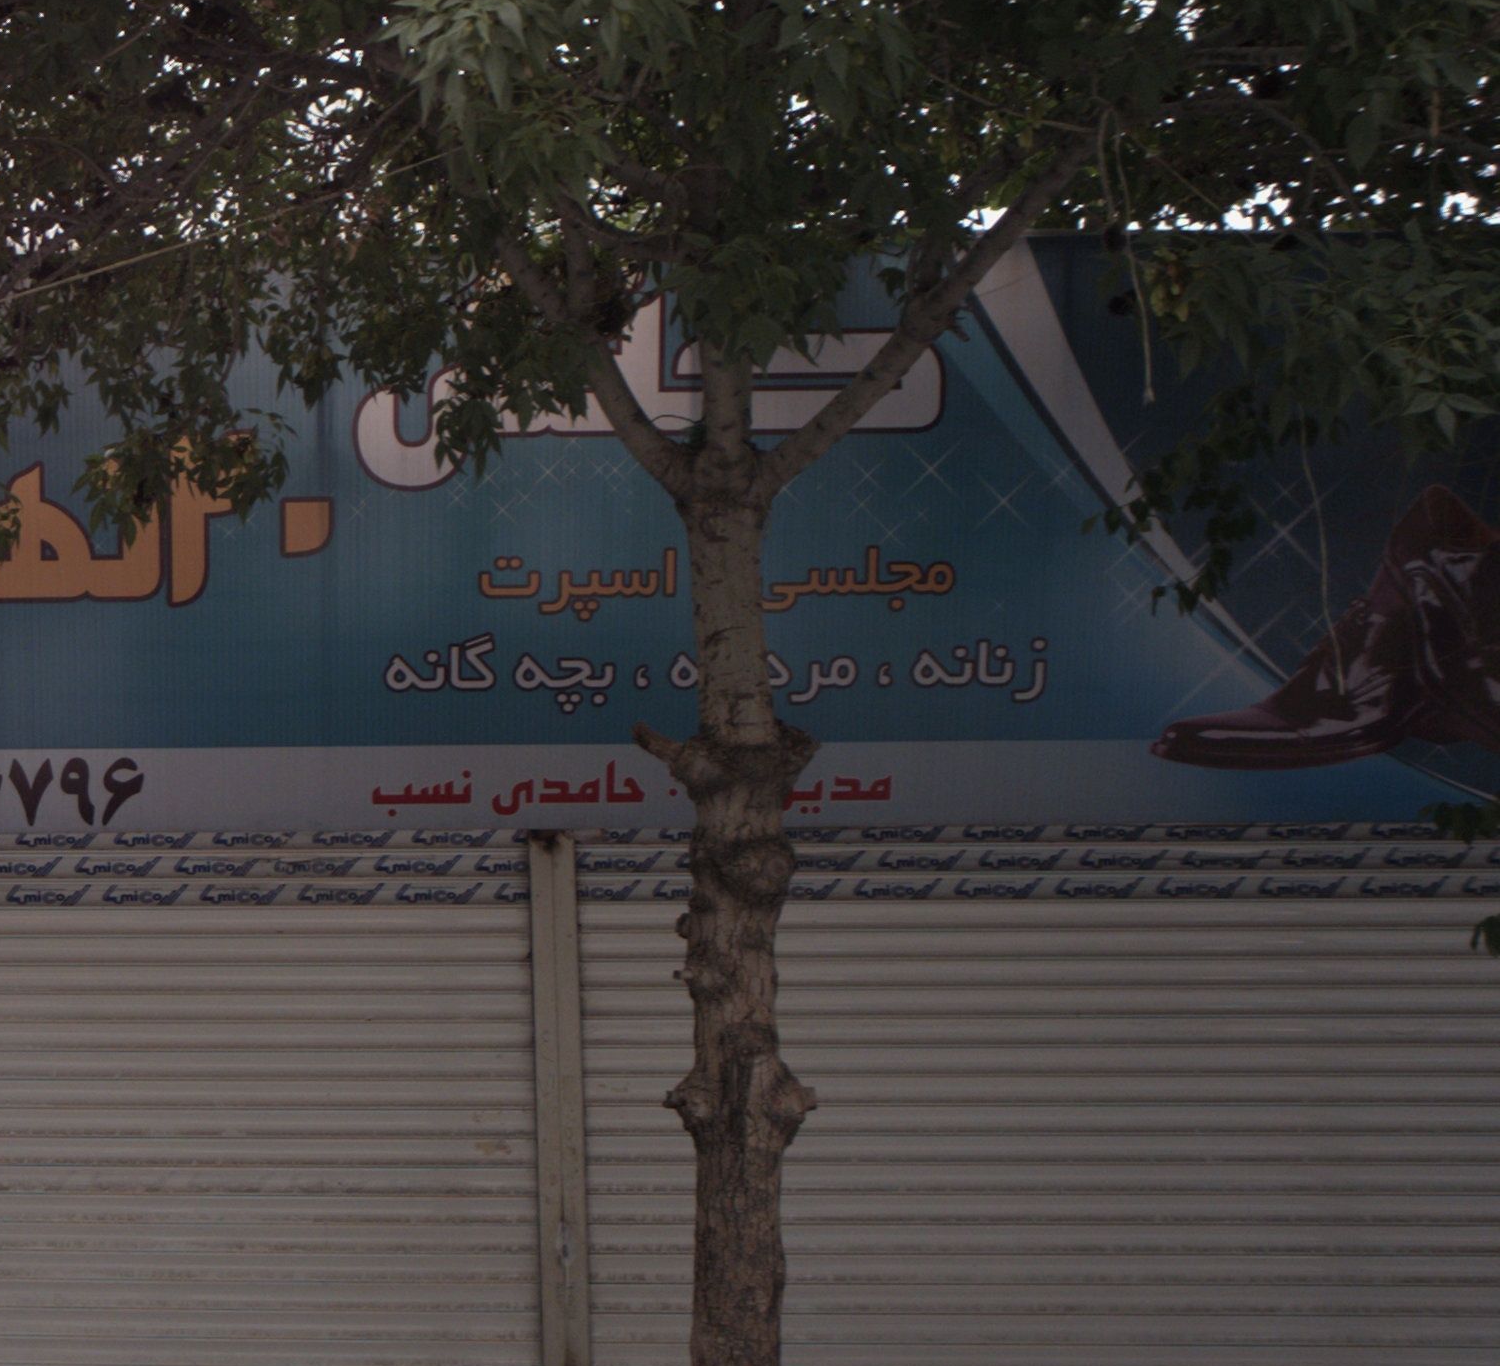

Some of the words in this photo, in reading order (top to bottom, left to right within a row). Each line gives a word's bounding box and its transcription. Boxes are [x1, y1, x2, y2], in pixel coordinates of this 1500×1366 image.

[478, 547, 677, 622] اسپرت
[762, 546, 955, 612] مجلسی
[383, 632, 497, 692] گانه
[513, 655, 617, 714] بچه
[668, 652, 858, 704] مرده
[911, 635, 1048, 703] زنانه
[372, 771, 473, 819] نسب
[491, 761, 646, 817] حامدی
